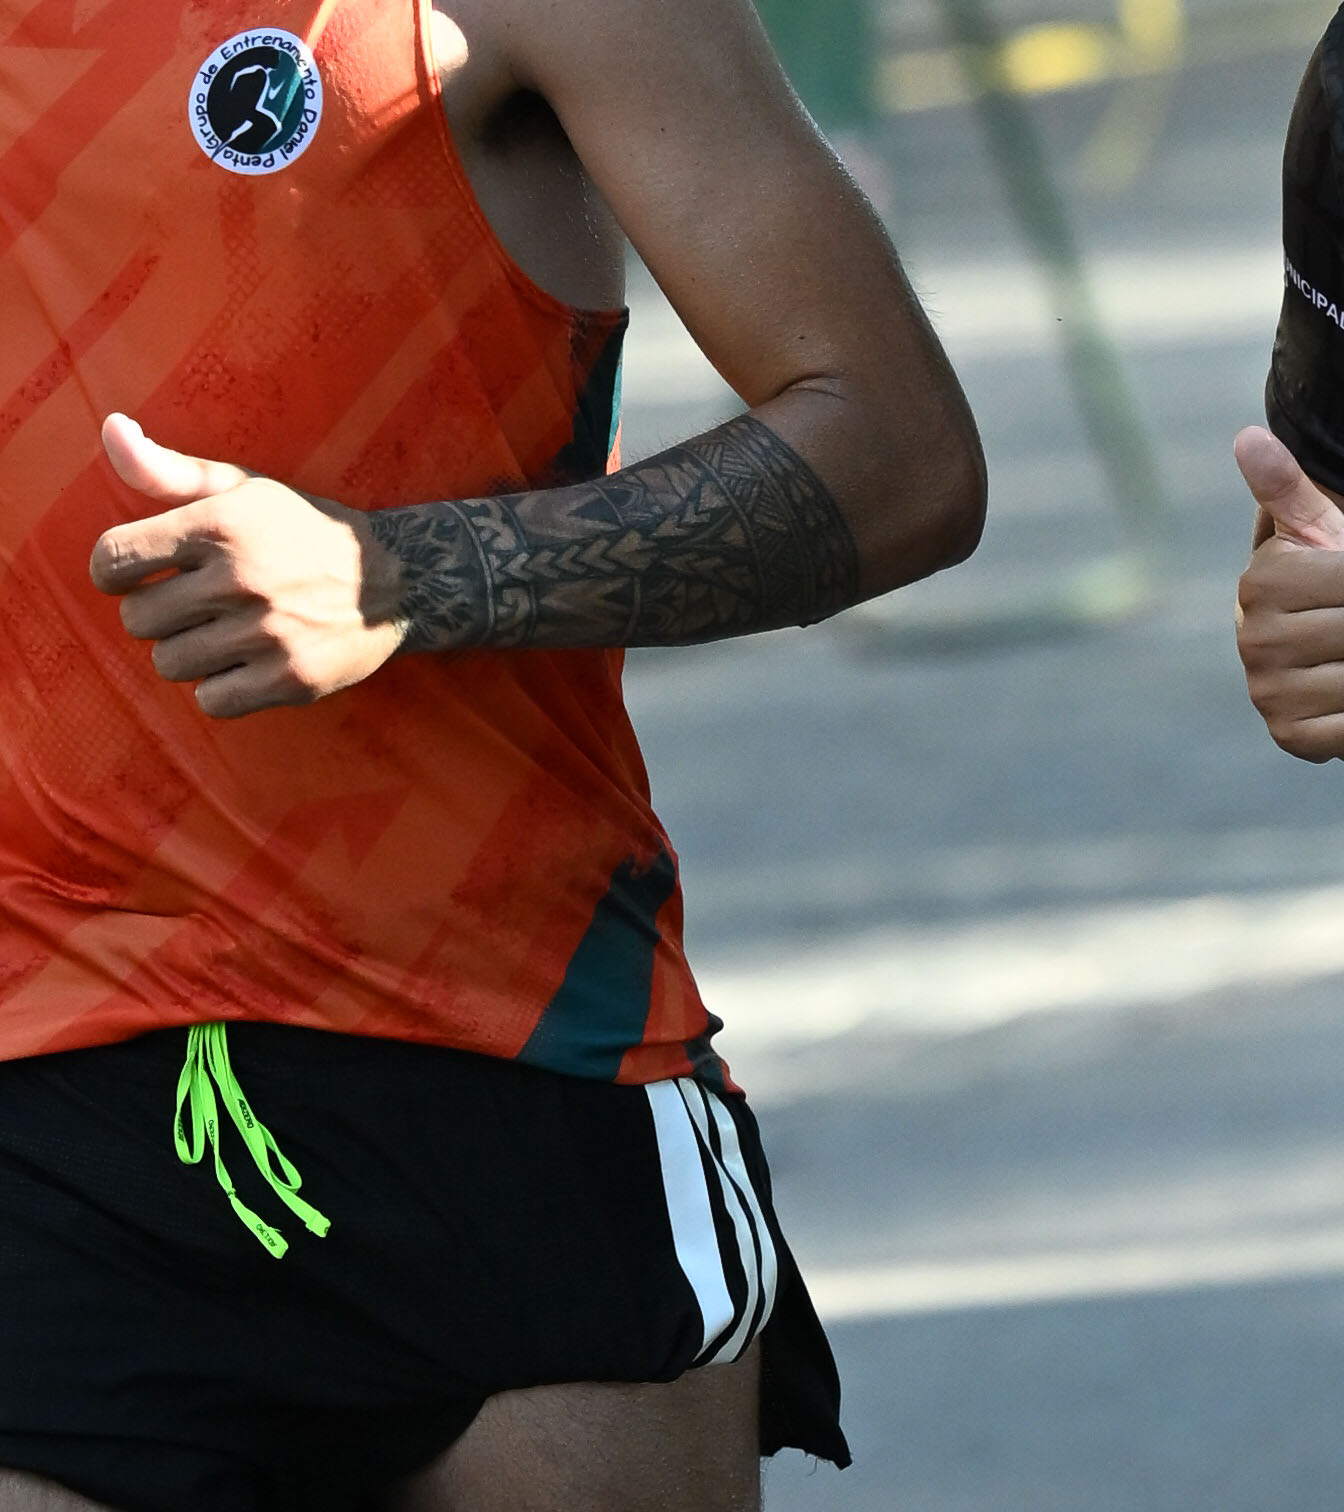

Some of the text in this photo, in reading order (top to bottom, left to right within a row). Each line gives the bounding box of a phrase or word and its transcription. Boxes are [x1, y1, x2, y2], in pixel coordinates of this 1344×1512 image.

[200, 64, 218, 85] de
[196, 93, 220, 150] Grupo
[280, 109, 317, 160] Daniel
[223, 149, 275, 168] Penta
